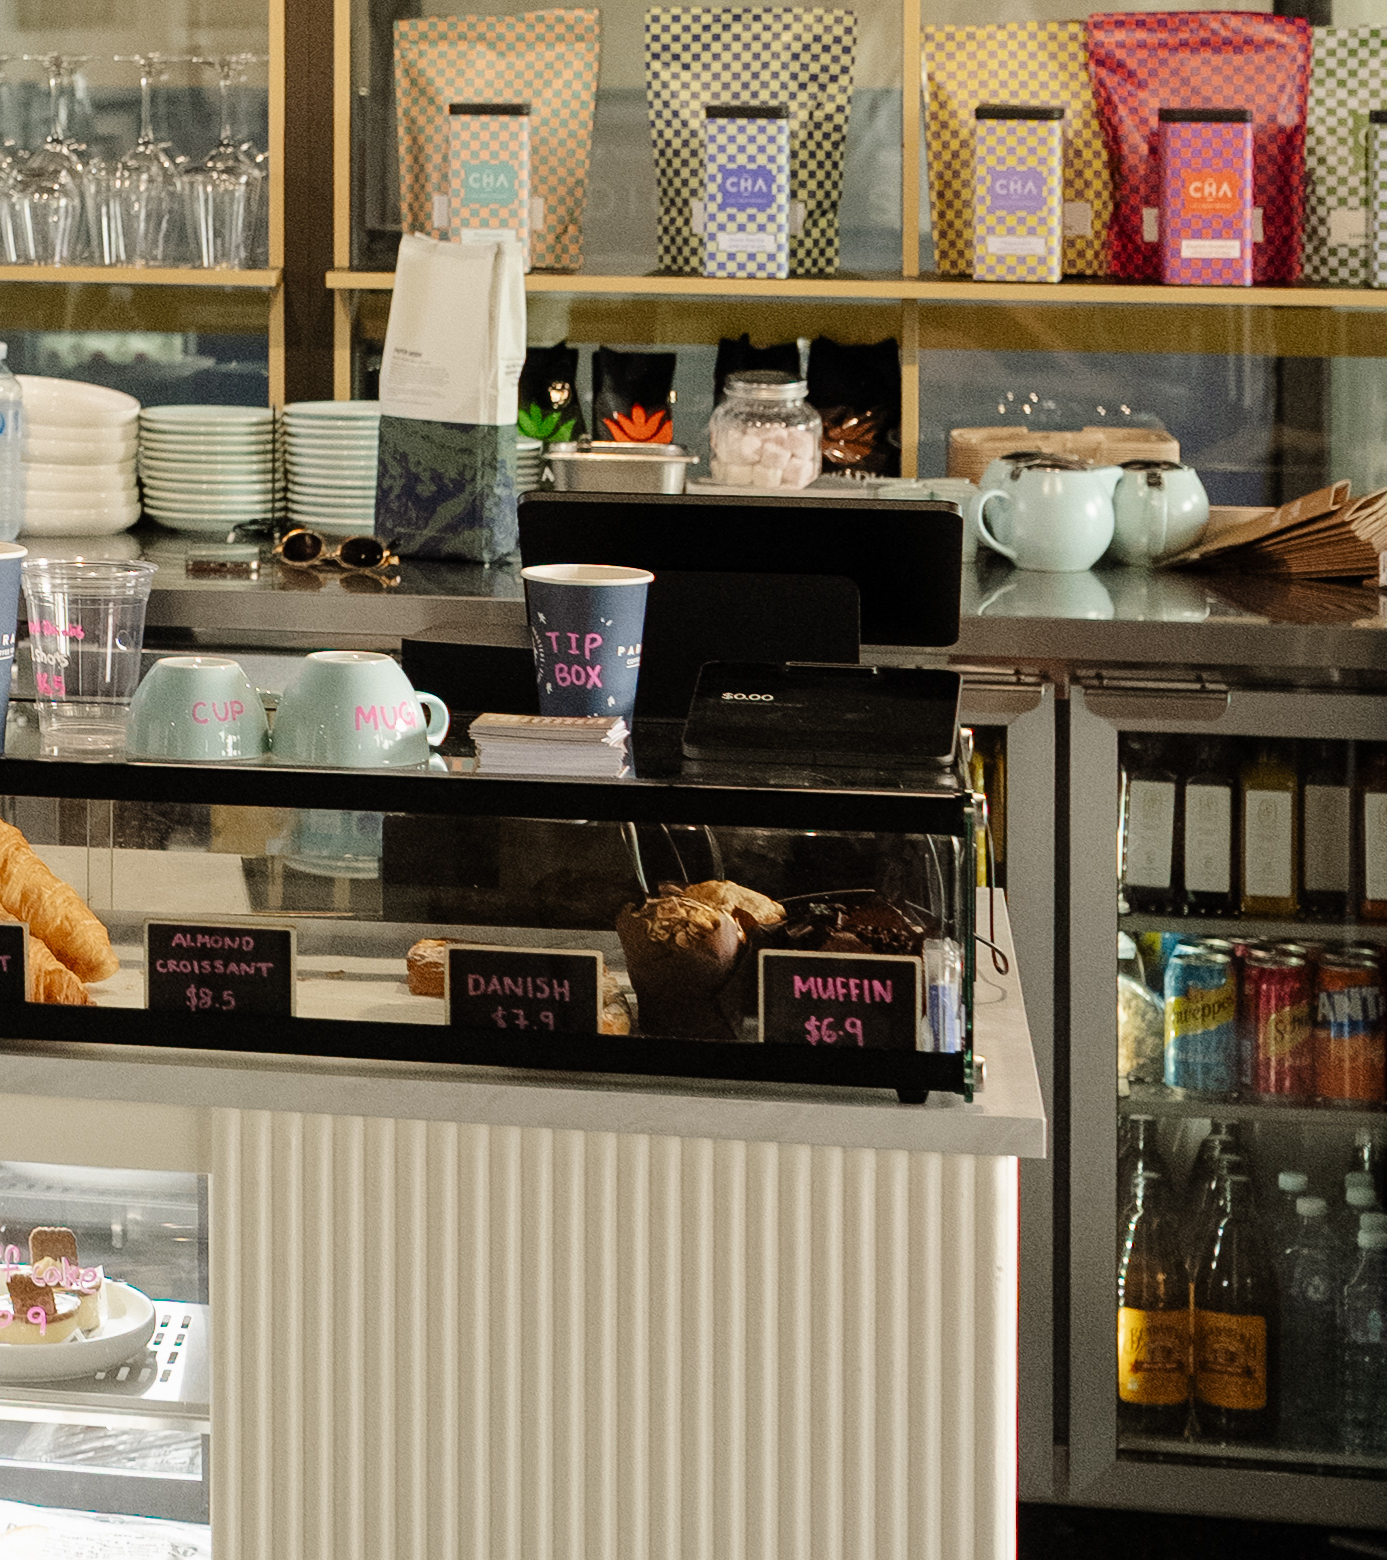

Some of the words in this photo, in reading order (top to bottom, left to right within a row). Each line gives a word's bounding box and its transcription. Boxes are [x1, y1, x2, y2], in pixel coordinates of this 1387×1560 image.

[545, 630, 603, 661] TIP
[554, 663, 603, 690] BOX
[721, 692, 774, 702] $0.00
[192, 700, 244, 725] CUP
[355, 701, 417, 732] MUG
[171, 932, 255, 952] ALMOND
[156, 958, 274, 978] CROISSANT
[185, 984, 236, 1011] $8.5
[467, 974, 571, 1003] DANISH
[793, 975, 893, 1004] MUFFIN
[491, 1007, 556, 1031] $7.9
[804, 1015, 865, 1048] $6.9
[31, 1256, 97, 1295] cake
